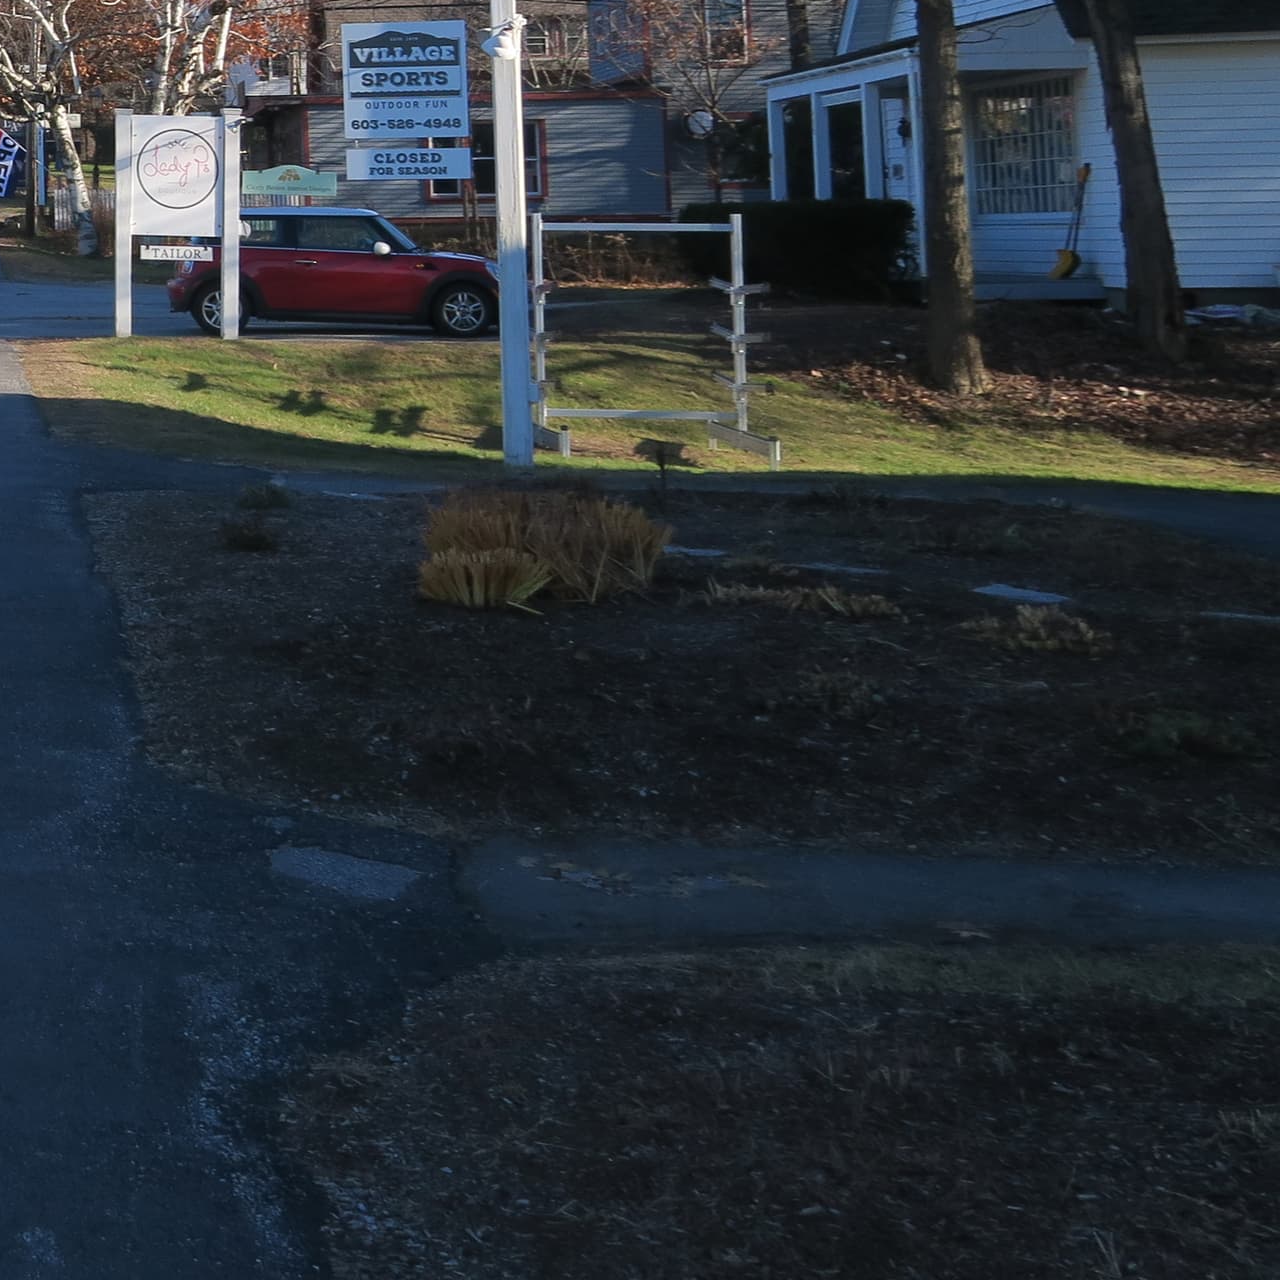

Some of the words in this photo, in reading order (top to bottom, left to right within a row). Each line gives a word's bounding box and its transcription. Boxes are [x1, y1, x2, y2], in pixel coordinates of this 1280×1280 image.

[353, 45, 455, 63] VILLAGE
[361, 71, 448, 87] SPORTS
[365, 101, 419, 110] OUTDOOR
[425, 100, 448, 108] FUN
[351, 118, 462, 130] 603-526-4948
[374, 153, 442, 163] CLOSED
[143, 144, 191, 187] Lady
[369, 167, 394, 175] FOR
[398, 166, 447, 175] SEASON
[152, 248, 201, 259] TAILOR
